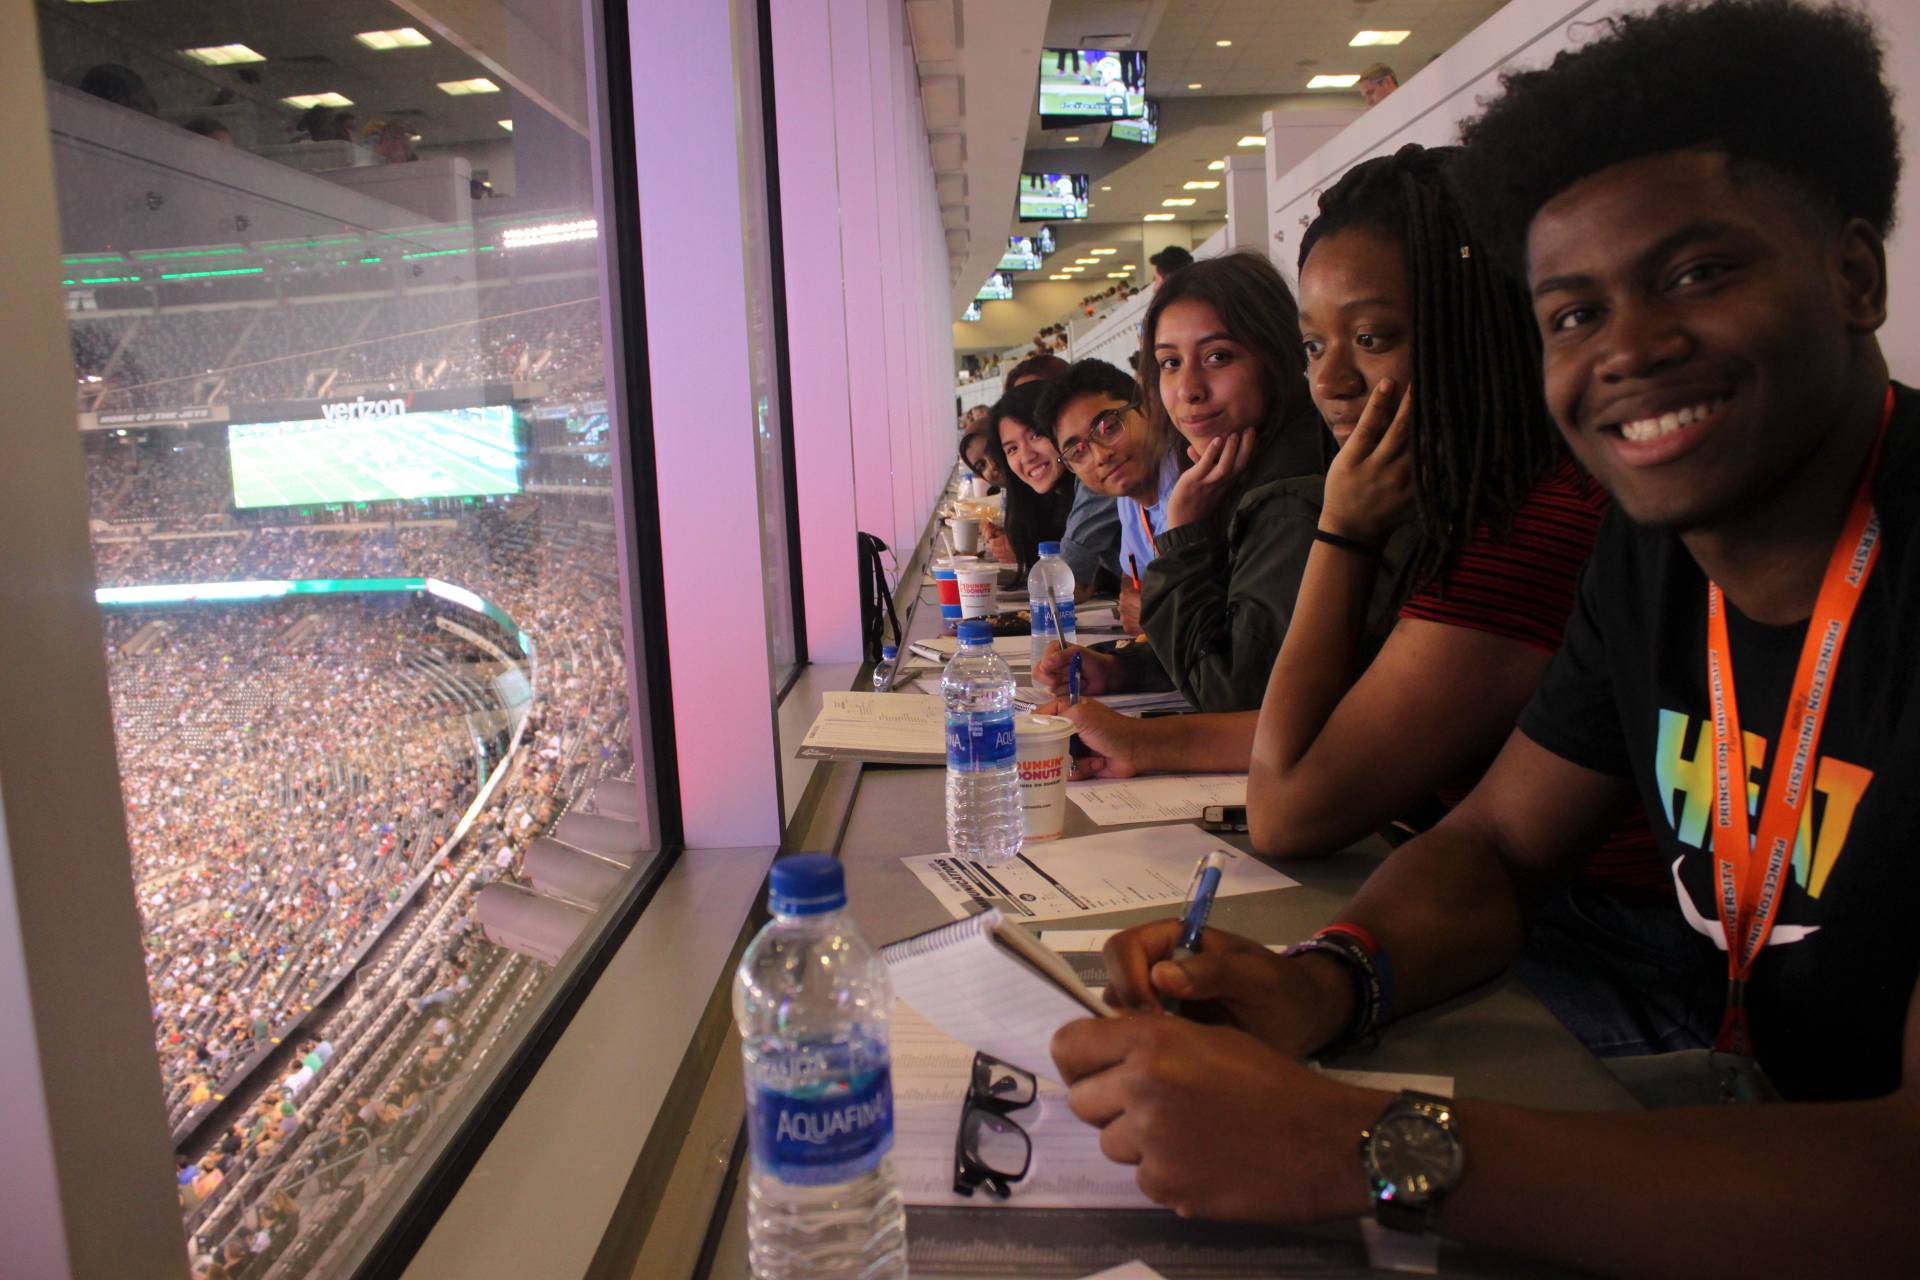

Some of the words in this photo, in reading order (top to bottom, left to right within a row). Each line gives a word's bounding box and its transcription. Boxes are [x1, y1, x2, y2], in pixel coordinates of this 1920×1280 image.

[321, 396, 406, 425] verizon
[1710, 650, 1726, 738] UNIVERSITY
[1807, 618, 1842, 711] PRINCETON
[1718, 742, 1732, 828] PRINCETON
[1784, 715, 1817, 809] UNIVERSITY
[1756, 837, 1788, 920] PRINCETON
